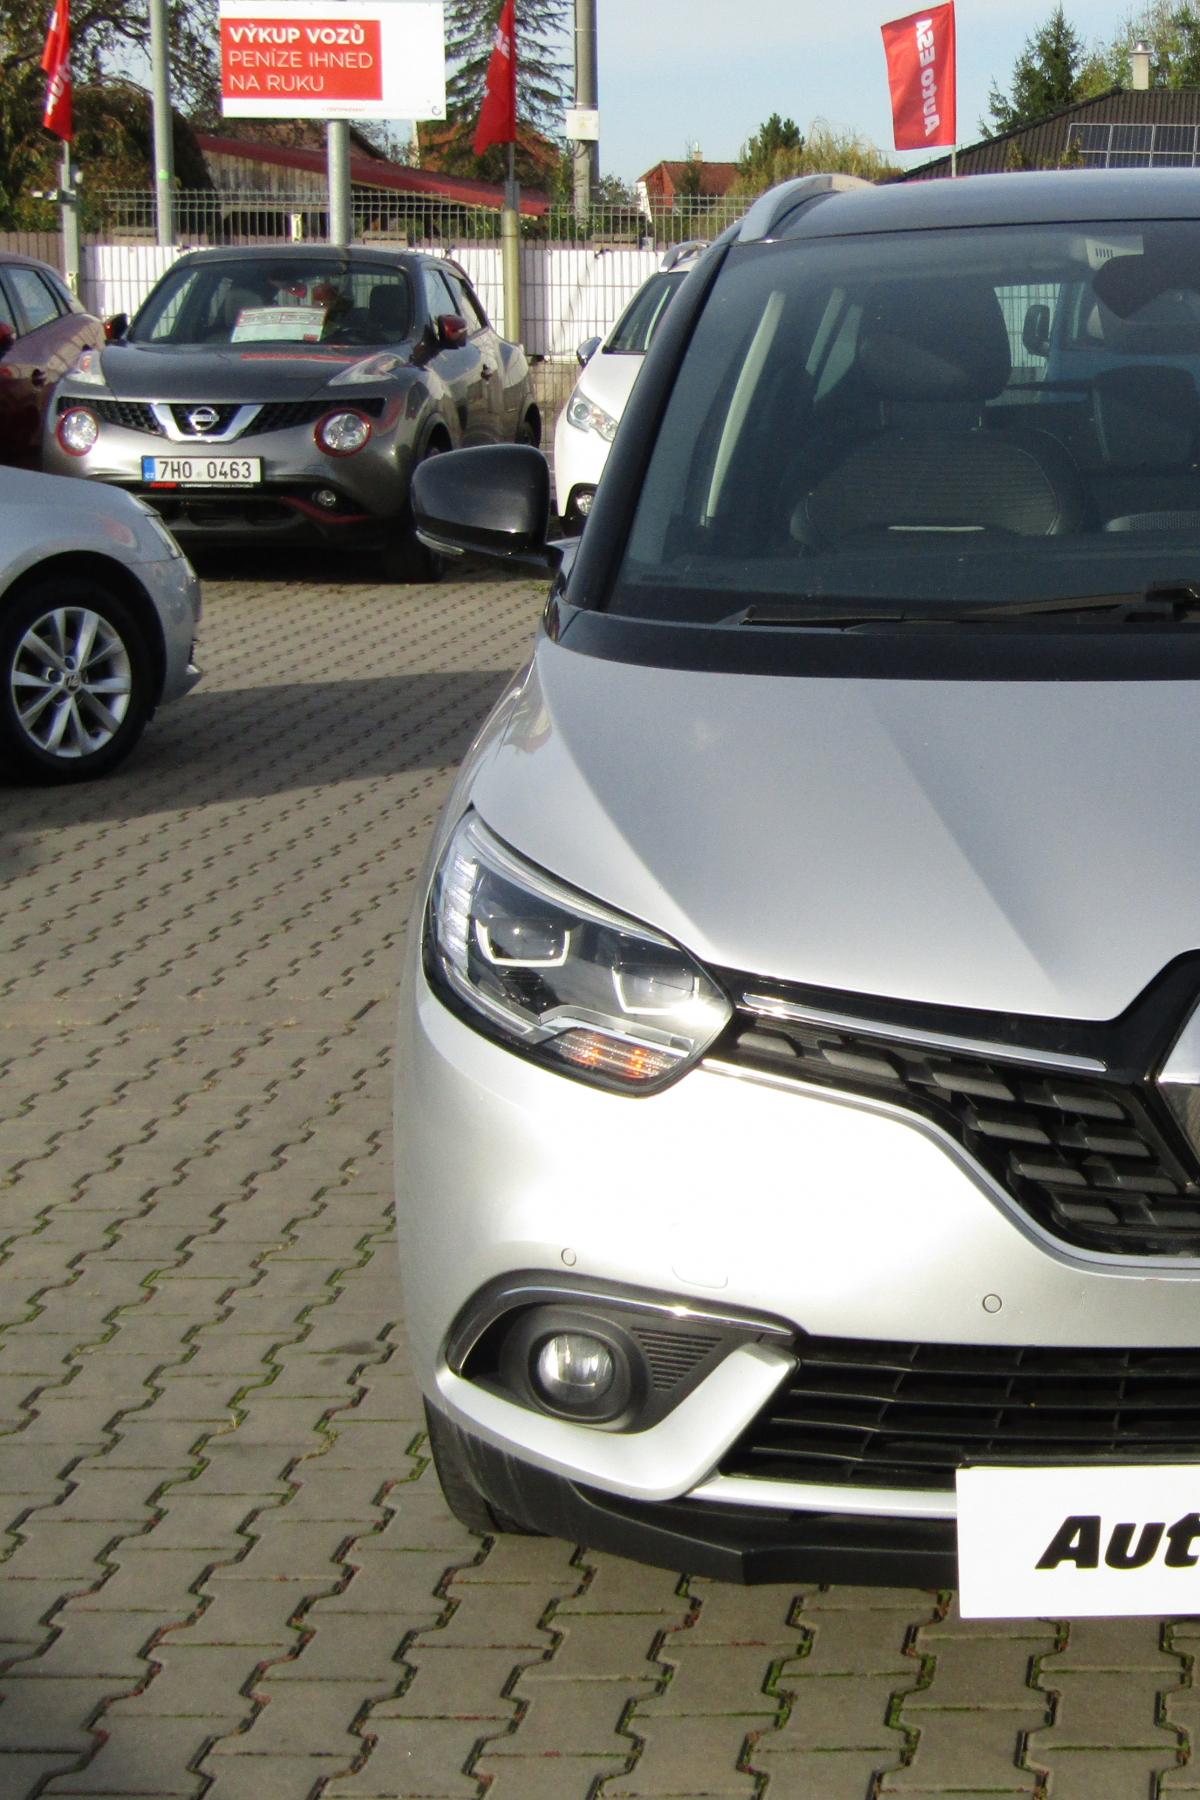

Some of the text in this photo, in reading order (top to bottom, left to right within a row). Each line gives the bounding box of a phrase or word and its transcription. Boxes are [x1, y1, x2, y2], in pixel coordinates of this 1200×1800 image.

[229, 23, 366, 45] VÝKUP VOZŮ
[229, 48, 373, 69] PENÍZE IHNED
[229, 75, 324, 92] NA RUKU
[207, 461, 252, 479] 0463
